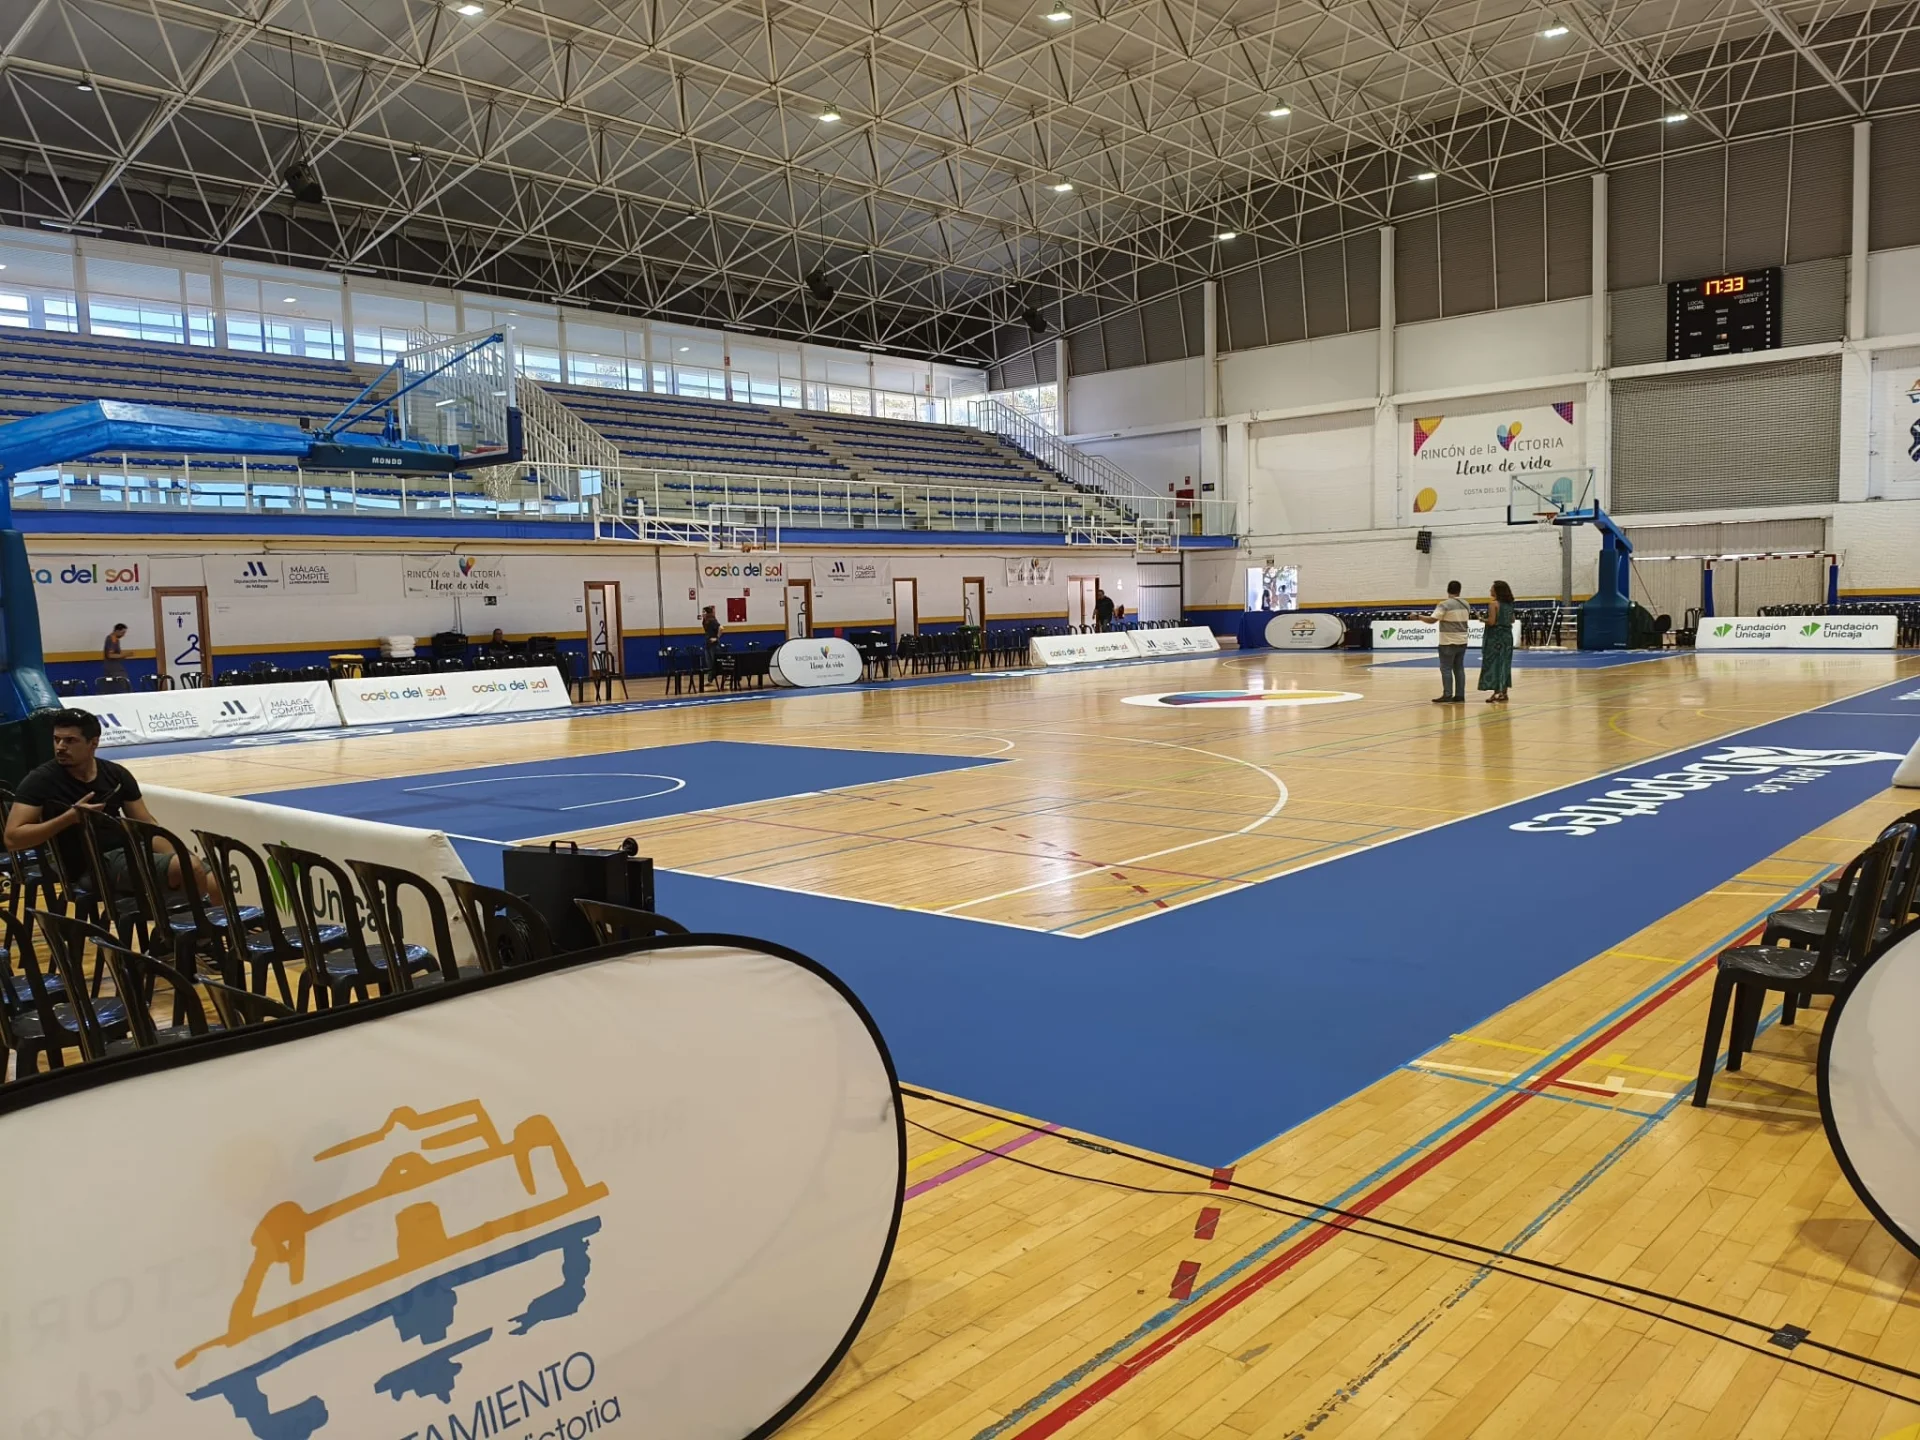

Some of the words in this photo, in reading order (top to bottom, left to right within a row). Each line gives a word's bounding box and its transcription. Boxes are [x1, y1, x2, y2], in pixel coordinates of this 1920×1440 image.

[1706, 277, 1744, 295] 17:33
[1421, 444, 1465, 460] RINCÓN
[1470, 445, 1482, 456] de
[1488, 444, 1496, 454] la
[372, 457, 402, 465] MONDO
[1499, 458, 1516, 472] de
[1520, 456, 1552, 470] vida
[61, 564, 97, 584] del
[105, 564, 139, 584] sol
[290, 565, 326, 573] MÁLAGA
[407, 569, 439, 578] RINCÓN
[705, 563, 739, 577] costa
[744, 562, 762, 576] del
[765, 563, 782, 577] sol
[457, 581, 468, 590] de
[470, 580, 489, 590] vida
[1824, 622, 1878, 631] Fundación
[1397, 633, 1424, 642] Unicaja
[1735, 631, 1771, 639] Unicaja
[1824, 630, 1862, 639] Unicaja
[472, 681, 506, 693] costa
[510, 680, 528, 691] del
[531, 678, 548, 689] sol
[361, 687, 399, 701] costa
[403, 687, 423, 699] del
[426, 685, 446, 696] sol
[149, 710, 192, 721] MÁLAGA
[271, 704, 315, 715] COMPITE
[149, 717, 198, 729] COMPITE
[1508, 763, 1782, 836] Deportes
[400, 1351, 595, 1440] MIENTO
[524, 1396, 621, 1440] toria
